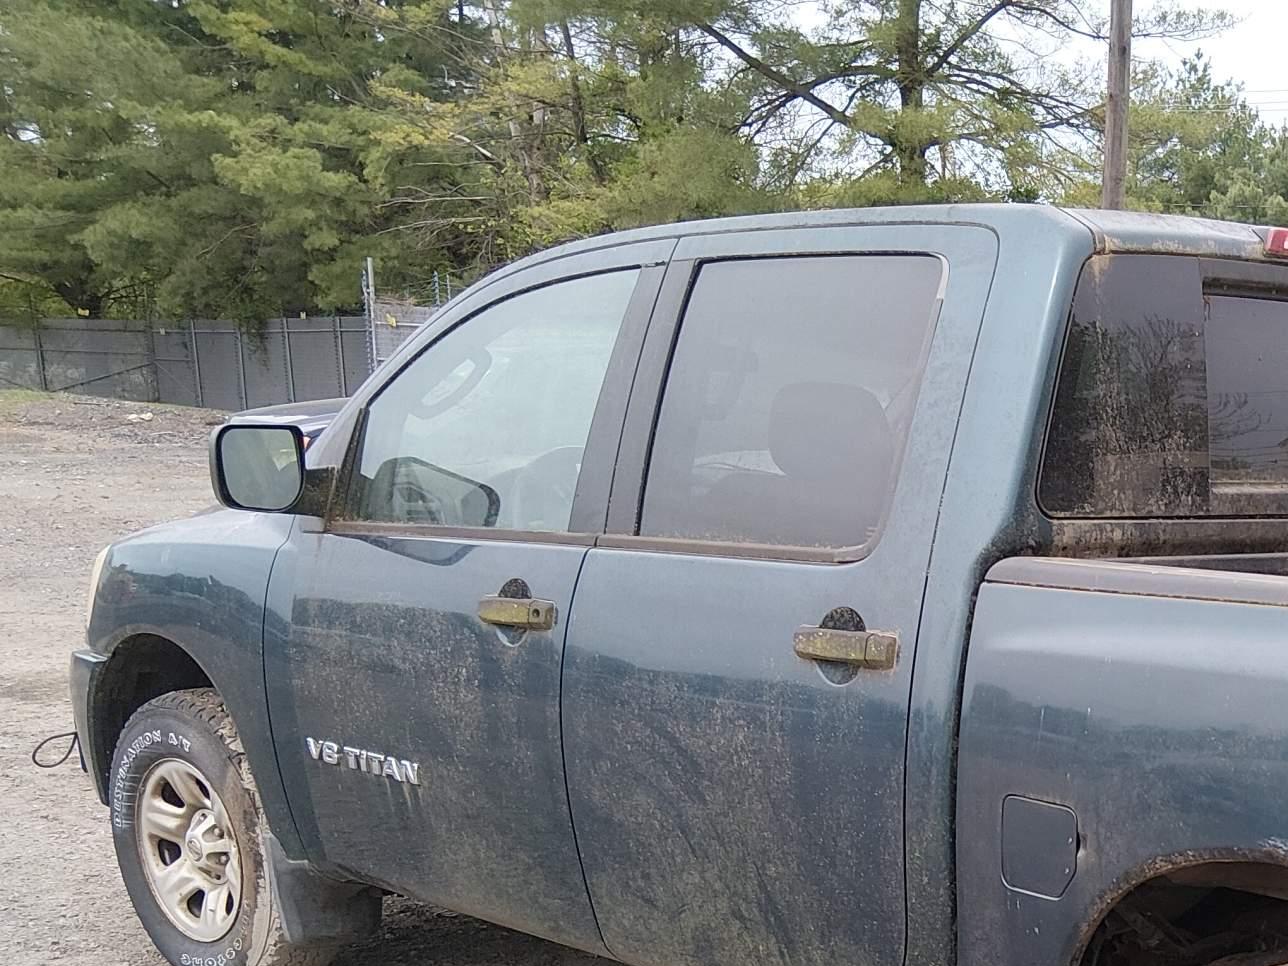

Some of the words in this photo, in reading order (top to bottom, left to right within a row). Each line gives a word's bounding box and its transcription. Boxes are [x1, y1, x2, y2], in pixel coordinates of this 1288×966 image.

[113, 729, 162, 828] DESTINATION
[168, 732, 192, 753] A/T
[306, 737, 340, 765] V8
[343, 746, 420, 785] TITAN
